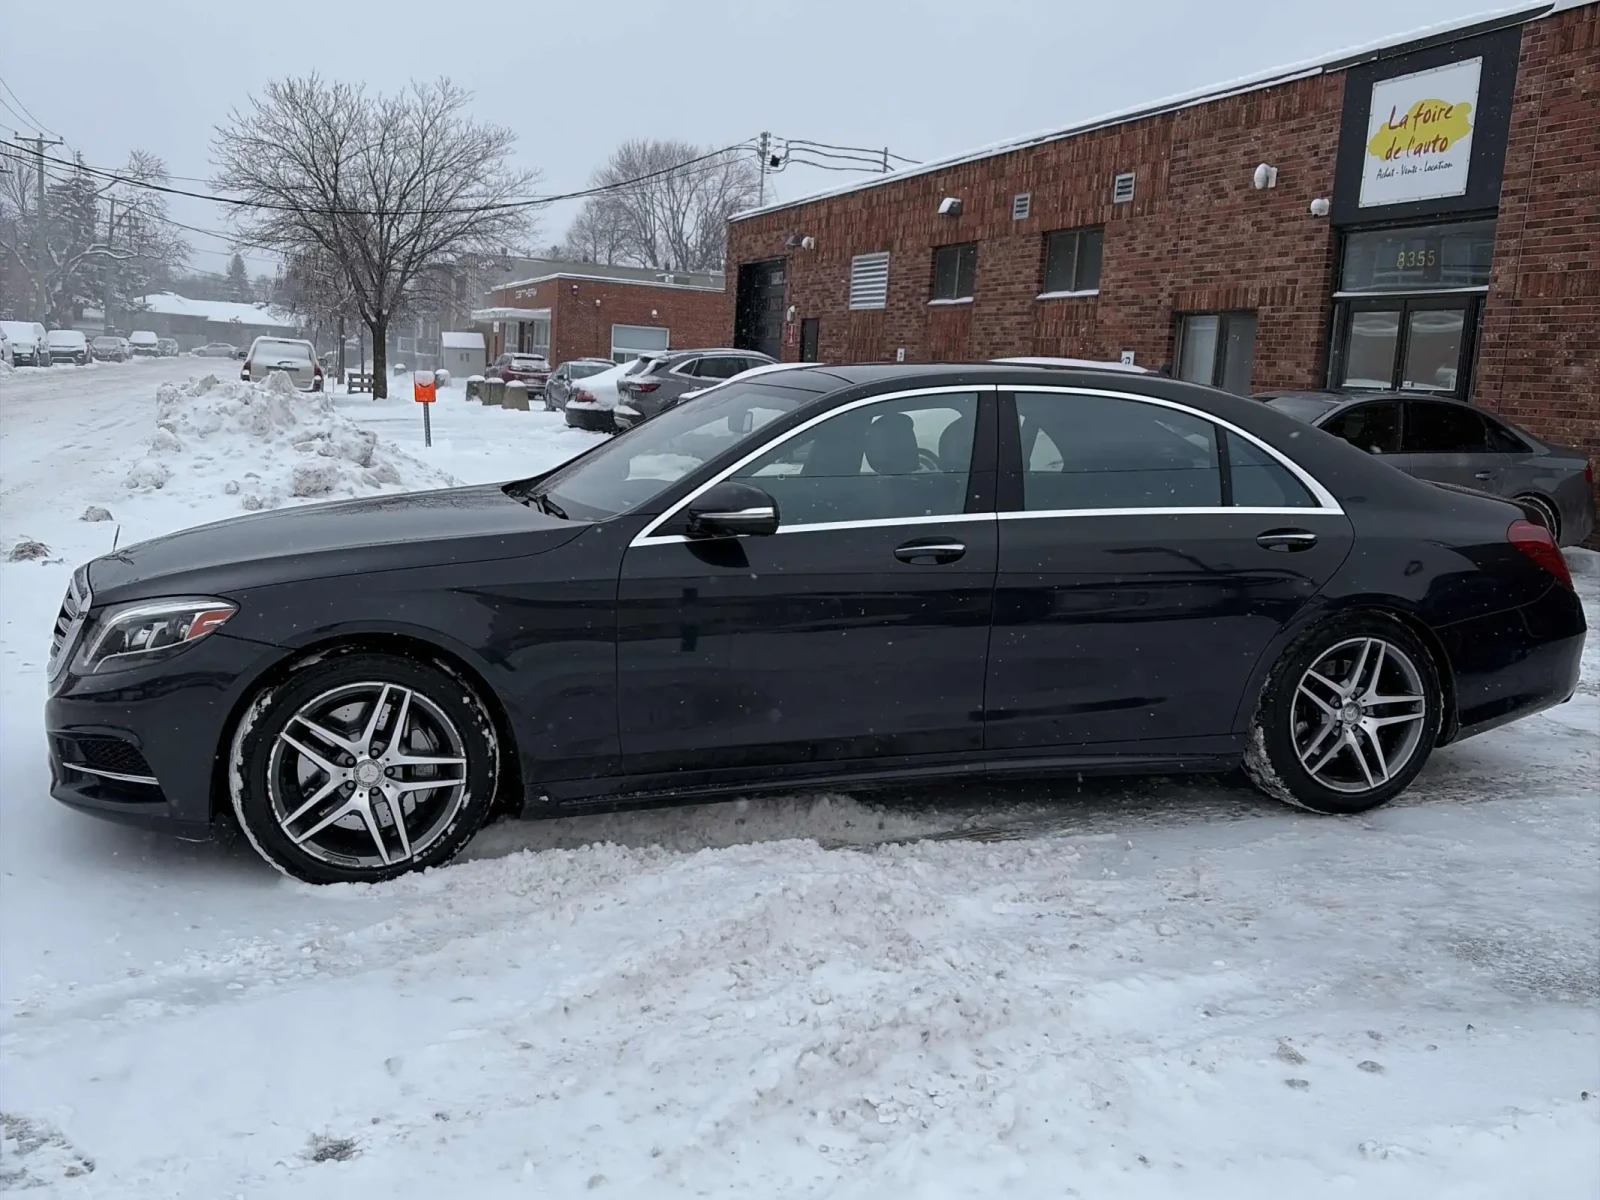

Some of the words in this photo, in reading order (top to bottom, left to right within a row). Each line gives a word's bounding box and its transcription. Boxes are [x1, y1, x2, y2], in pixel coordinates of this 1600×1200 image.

[1389, 104, 1409, 130] La
[1413, 102, 1454, 132] foire
[1385, 136, 1402, 162] de
[1406, 133, 1448, 158] l'auto
[1376, 167, 1396, 180] Achat
[1401, 164, 1418, 176] Vente
[1424, 160, 1453, 173] Location
[1396, 250, 1435, 269] 8355
